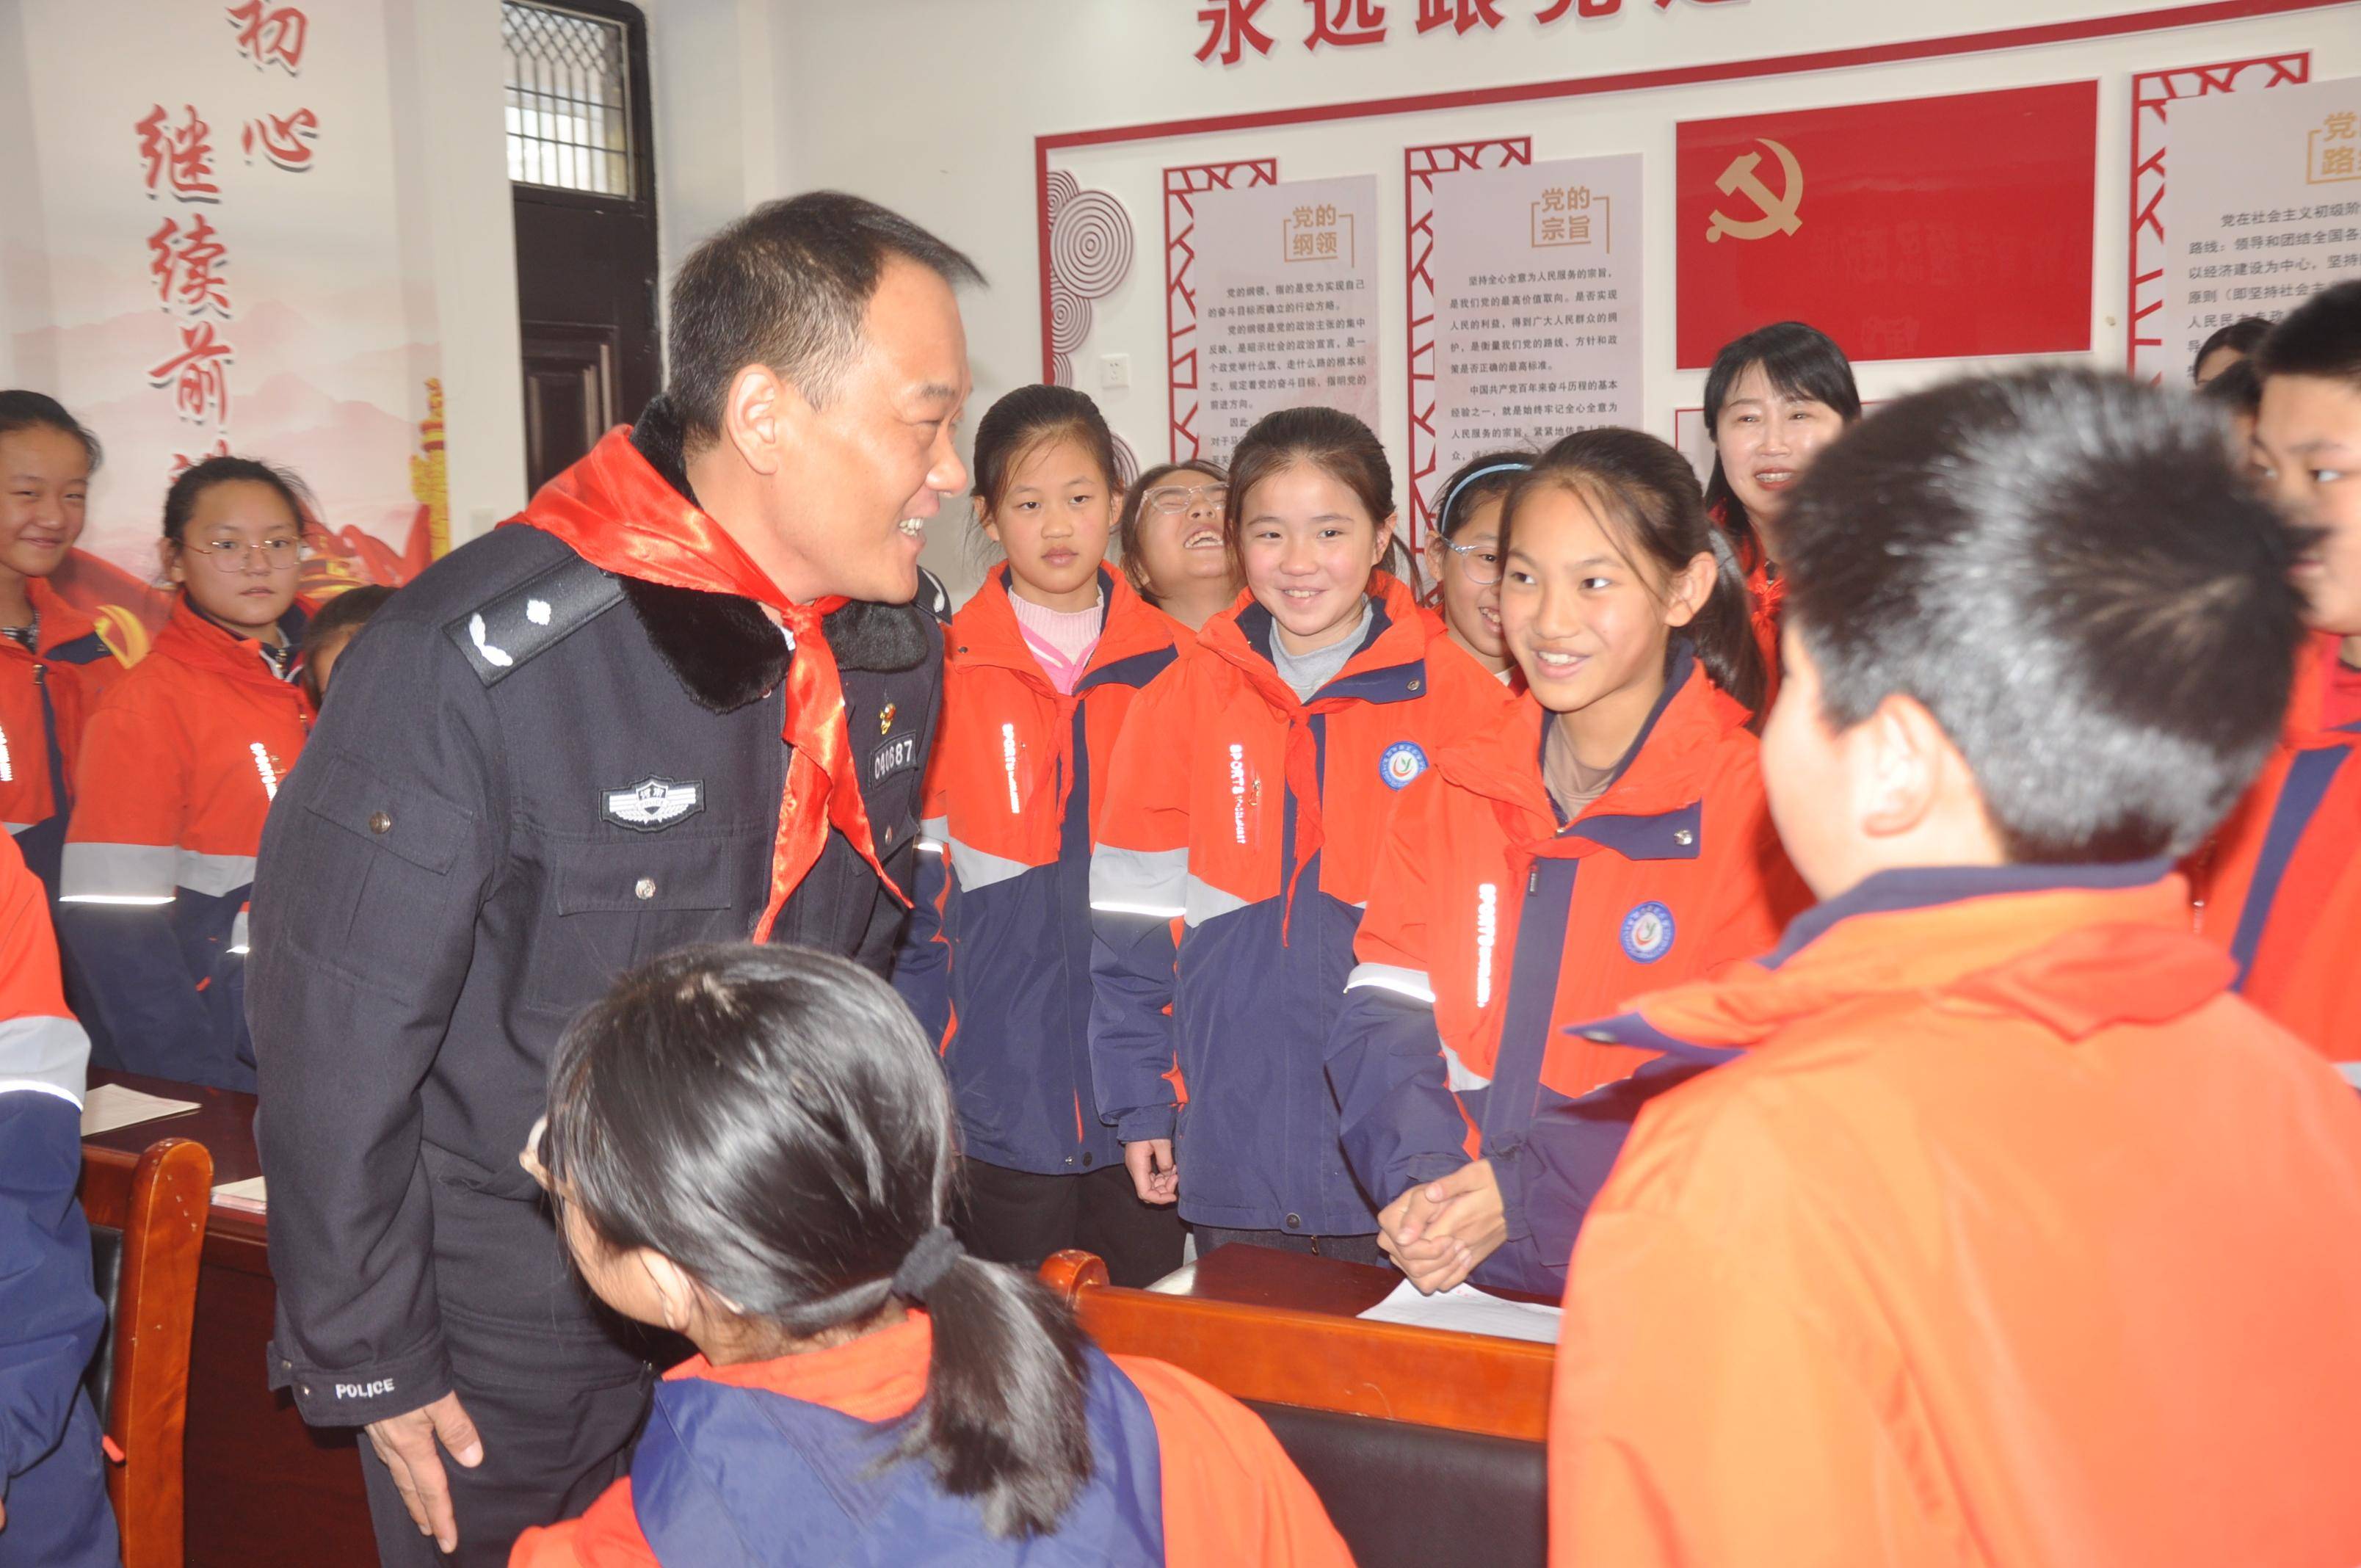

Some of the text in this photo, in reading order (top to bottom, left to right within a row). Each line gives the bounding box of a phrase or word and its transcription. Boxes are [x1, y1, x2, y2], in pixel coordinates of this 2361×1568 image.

[228, 0, 319, 164] 初心
[2323, 111, 2361, 142] 党
[2322, 146, 2361, 175] 路
[1542, 186, 1590, 213] 党的
[1292, 203, 1336, 229] 党的
[1542, 216, 1590, 241] 宗旨
[1293, 231, 1337, 255] 纲领
[2188, 228, 2361, 254] 路线：领导和团结全国各
[2188, 253, 2361, 279] 以经济建设为中心，坚持
[134, 104, 233, 482] 继续前
[1449, 289, 1617, 308] 是我们党的最高价值取向。是否实现
[1451, 360, 1553, 374] 策是否正确的最高标准。
[1470, 380, 1617, 396] 中国共产党百年来奋斗历程的基本
[1211, 400, 1253, 410] 前进方向。
[336, 1378, 395, 1400] POLICE
